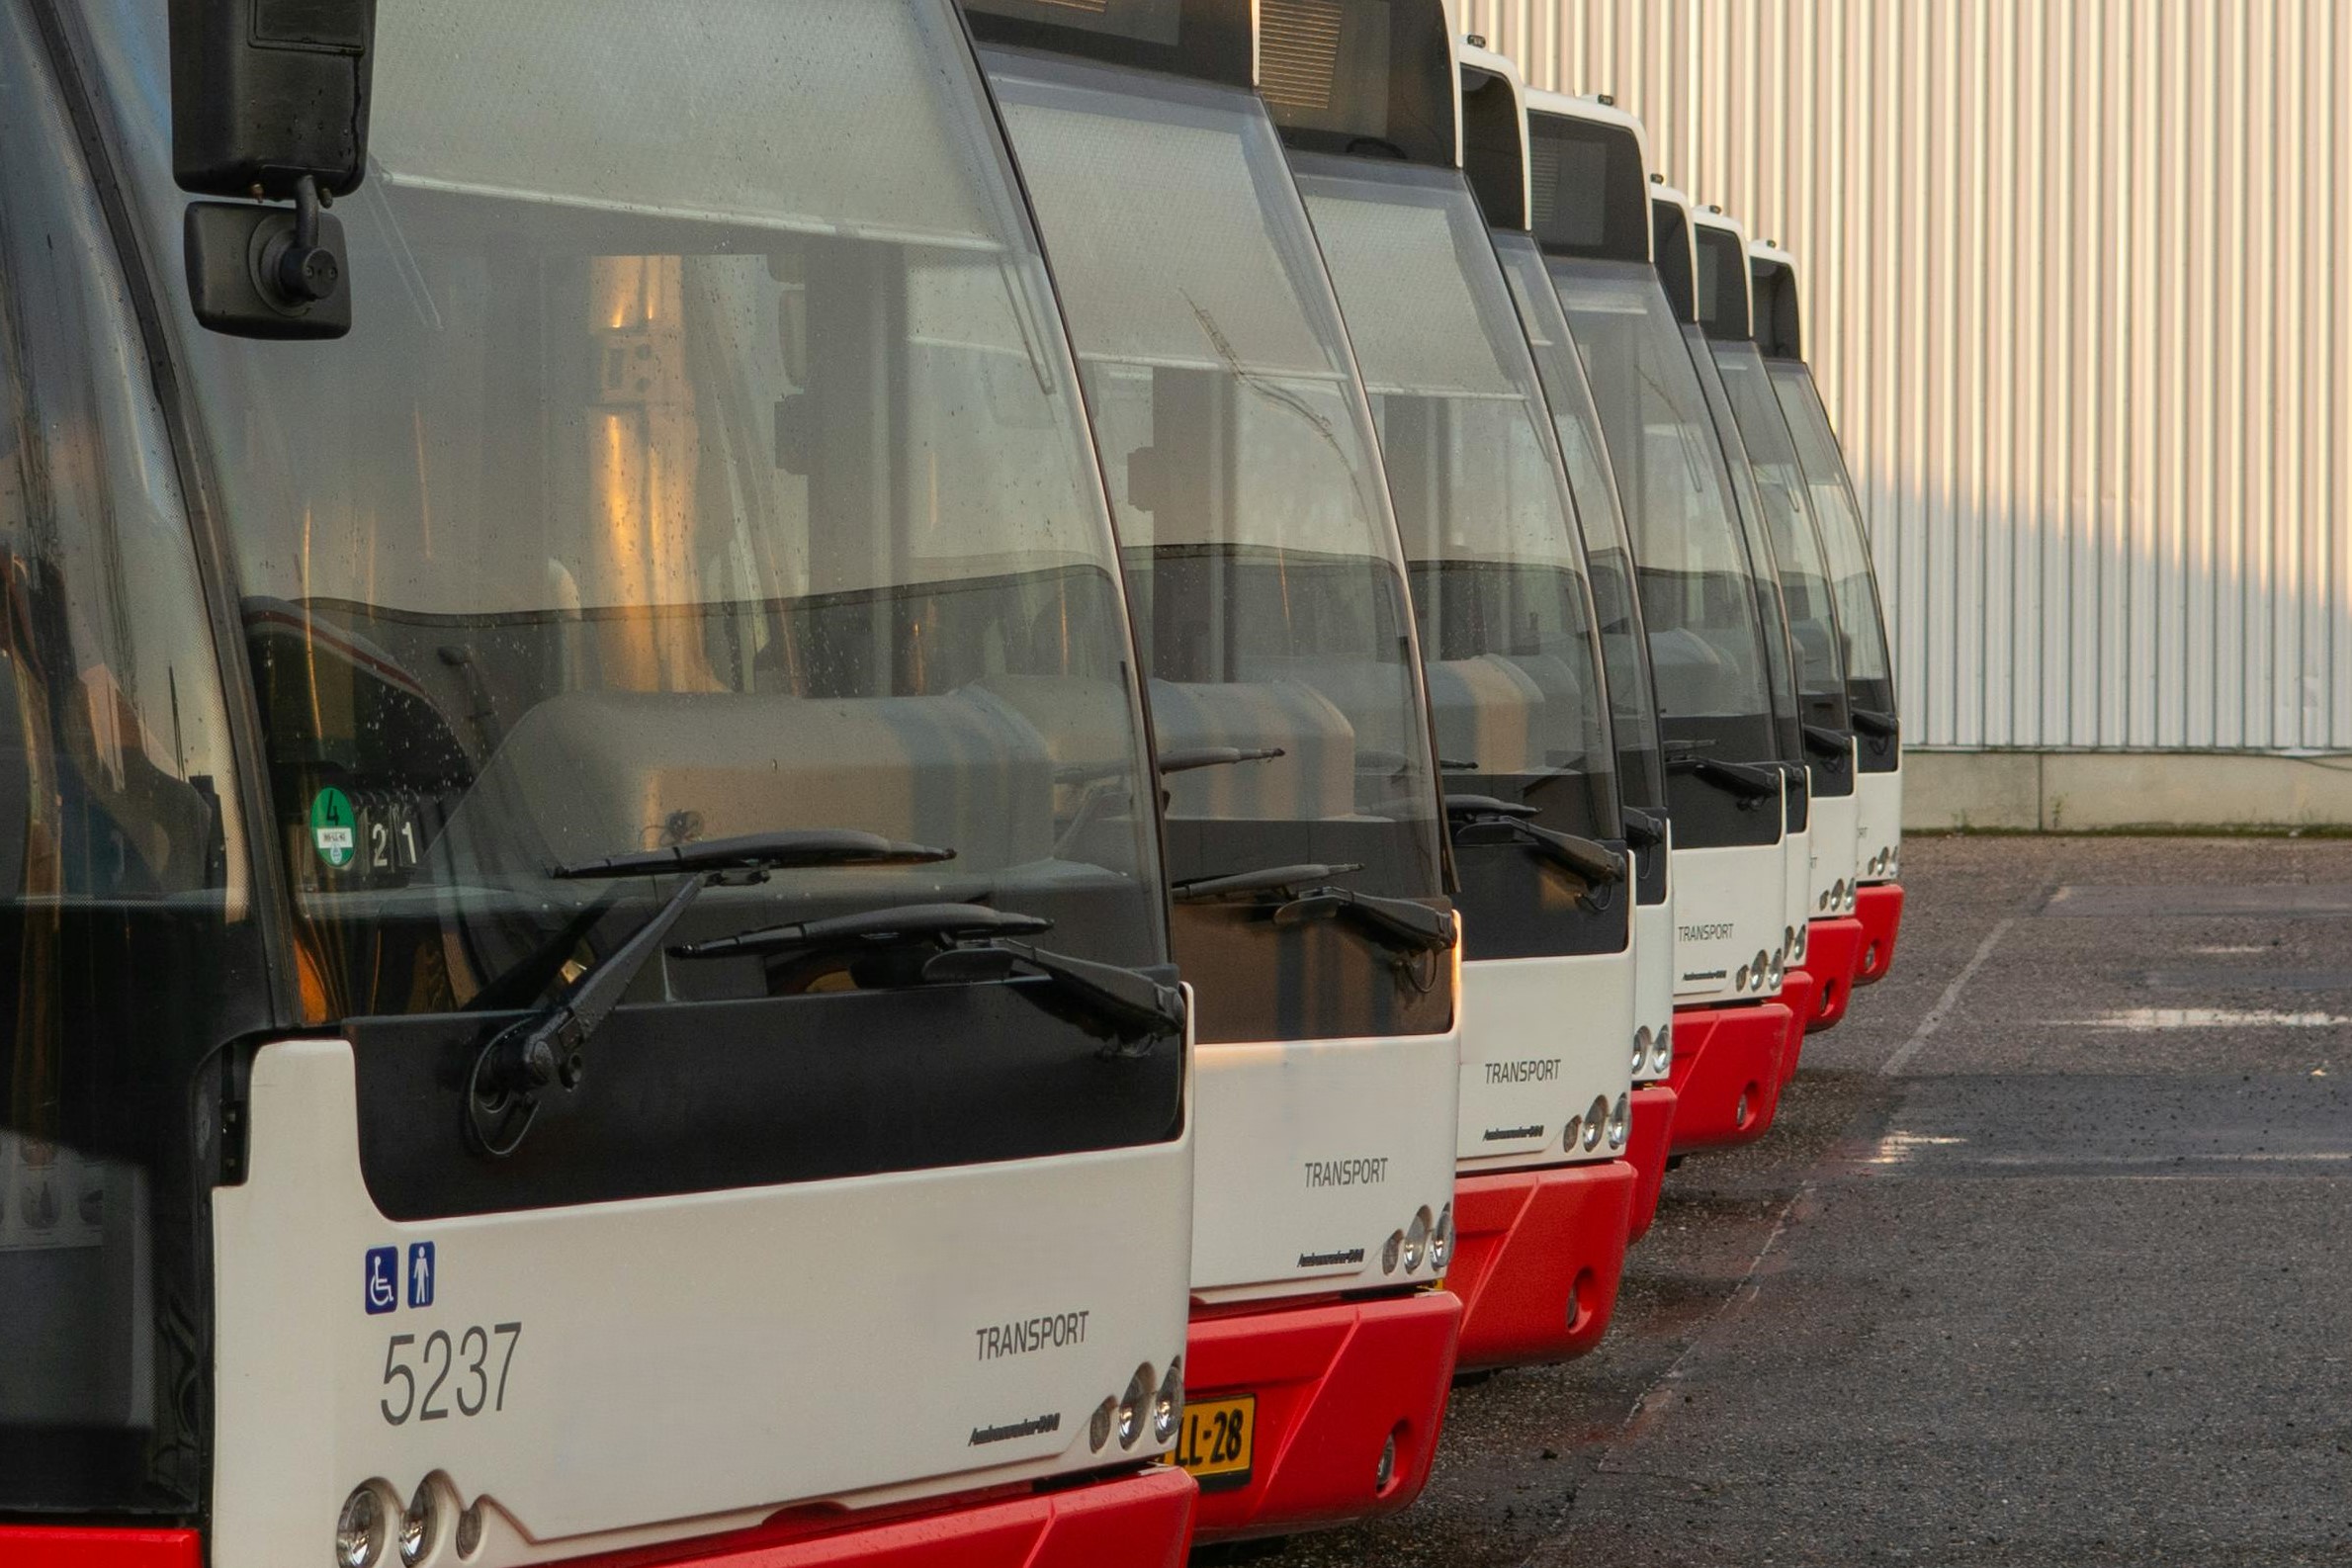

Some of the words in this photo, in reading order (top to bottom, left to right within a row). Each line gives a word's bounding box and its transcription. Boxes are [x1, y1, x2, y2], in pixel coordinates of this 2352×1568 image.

[1678, 923, 1734, 942] TRANSPORT
[1485, 1059, 1562, 1085] TRANSPORT
[1304, 1157, 1388, 1188] TRANSPORT
[976, 1310, 1089, 1360] TRANSPORT
[380, 1321, 523, 1427] 5237
[1167, 1408, 1245, 1466] LL-28
